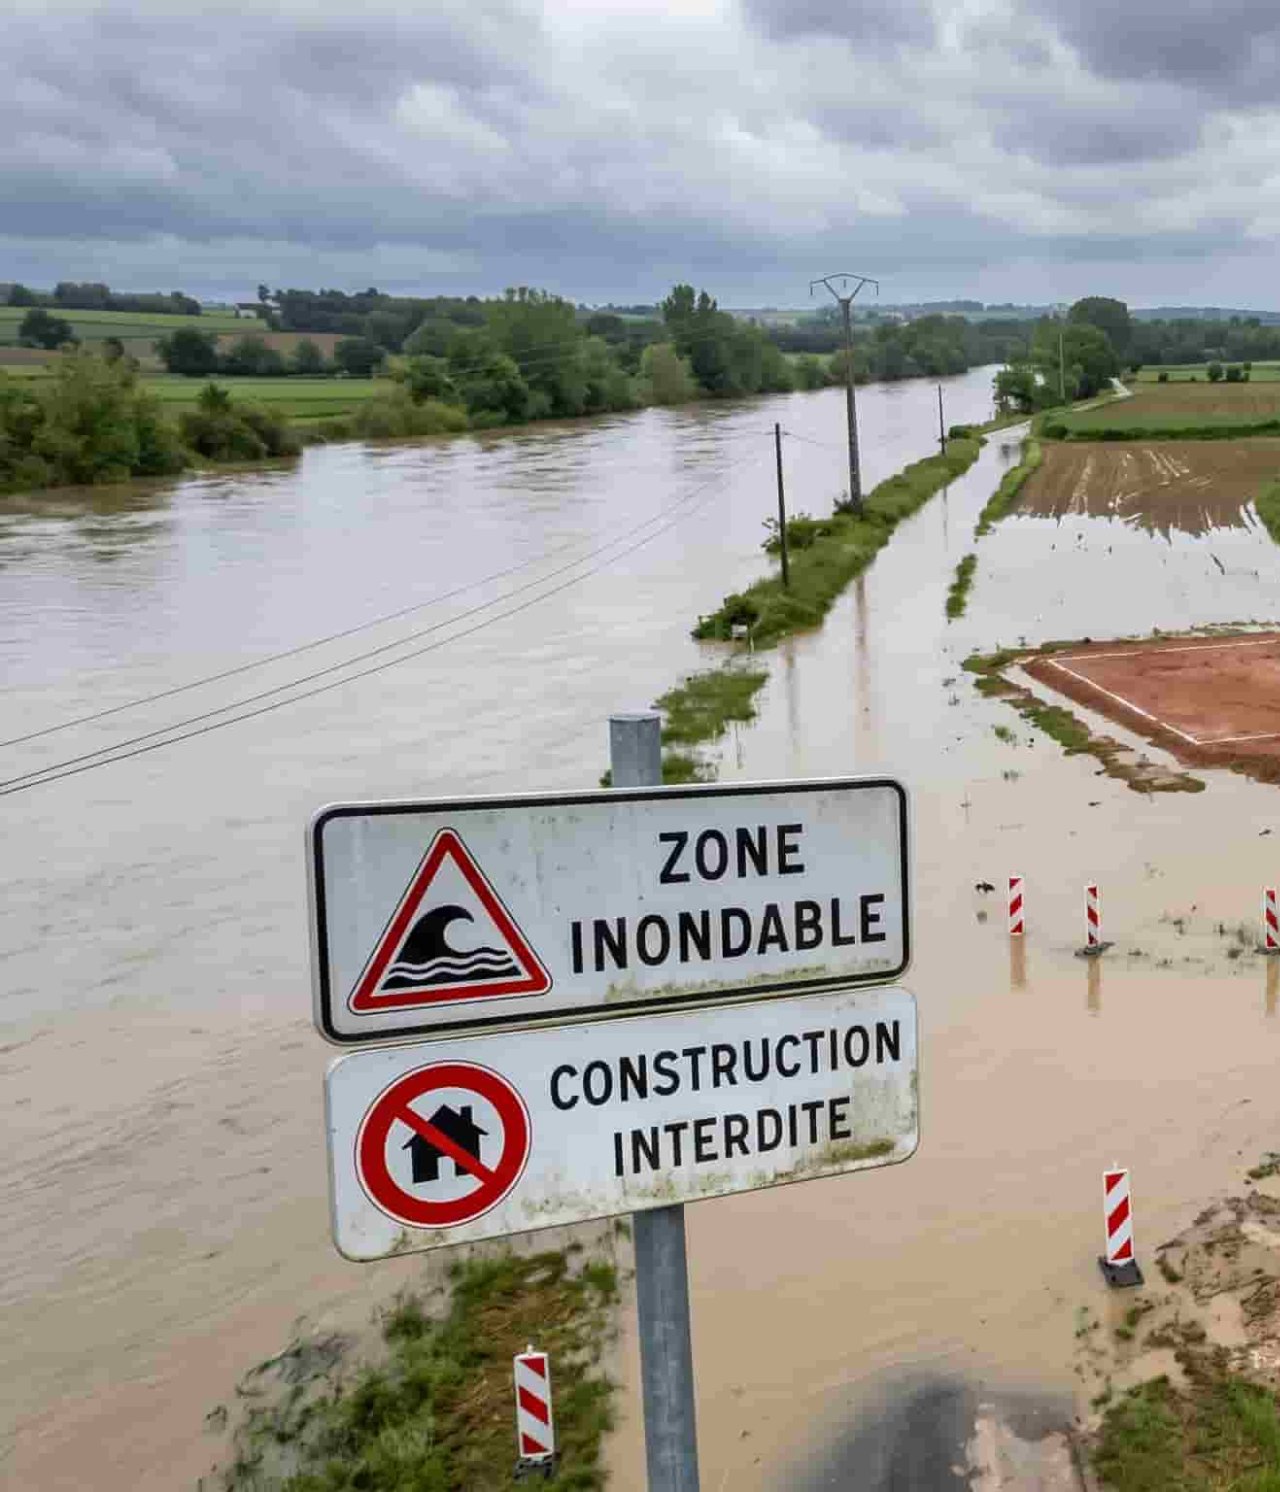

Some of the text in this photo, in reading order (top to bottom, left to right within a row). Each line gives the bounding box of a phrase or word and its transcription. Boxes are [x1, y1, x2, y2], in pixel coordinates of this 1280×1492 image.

[658, 823, 805, 885] ZONE
[571, 893, 887, 974] INONDABLE
[550, 1019, 901, 1111] CONSTRUCTION
[613, 1095, 852, 1177] INTERDITE
